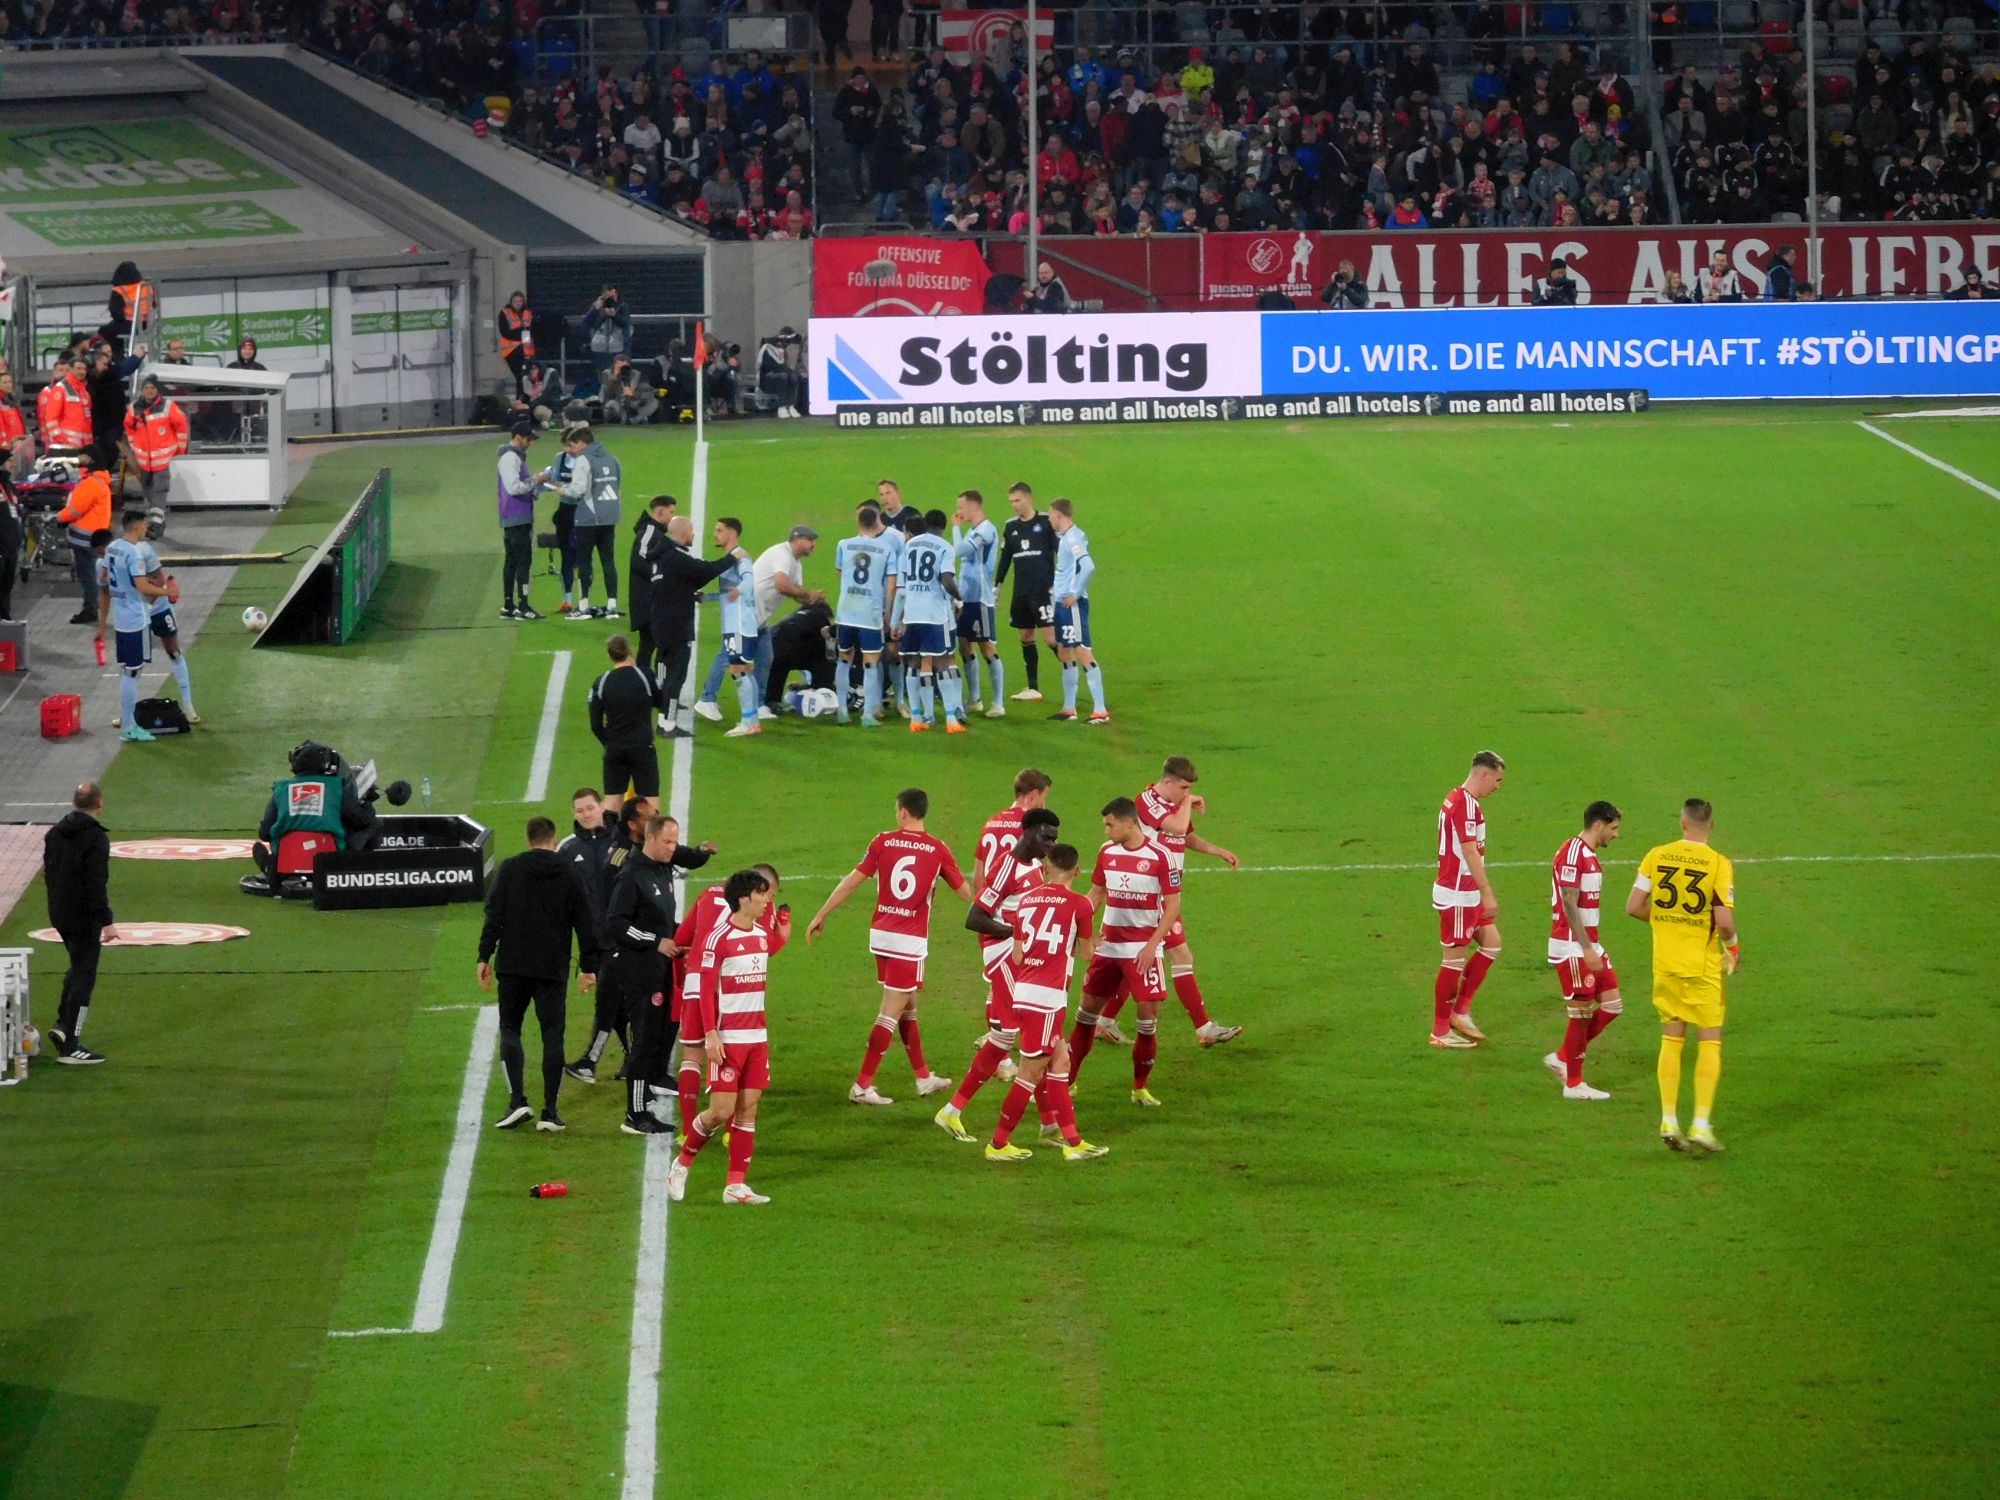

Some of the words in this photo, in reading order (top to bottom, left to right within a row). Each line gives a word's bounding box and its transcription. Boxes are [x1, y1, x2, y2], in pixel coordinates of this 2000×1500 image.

[878, 246, 942, 264] OFFENSIVE
[1367, 241, 1592, 308] ALLES
[1208, 284, 1254, 300] JUGEND
[1280, 283, 1312, 296] TOUR
[900, 331, 1208, 392] Stölting
[1292, 345, 1350, 374] DU.
[1361, 343, 1438, 372] WIR.
[1449, 342, 1505, 371] DIE
[1516, 338, 1766, 369] MANNSCHAFT.
[1043, 407, 1073, 422] me
[1080, 403, 1117, 421] and
[1123, 402, 1147, 420] all
[1154, 400, 1217, 419] hotels
[1246, 402, 1277, 417] me
[1283, 398, 1321, 416] and
[1327, 397, 1351, 414] all
[1357, 395, 1421, 414] hotels
[1450, 398, 1480, 413] me
[1487, 395, 1525, 413] and
[1531, 394, 1554, 412] all
[1561, 393, 1625, 412] hotels
[840, 413, 870, 426] me
[877, 409, 914, 425] and
[920, 407, 944, 424] all
[951, 405, 1014, 424] hotels
[853, 552, 871, 585] 8
[907, 549, 936, 582] 18
[1061, 625, 1076, 640] 22
[380, 836, 425, 847] IGA.DE
[884, 838, 936, 853] DÜSSELDORF
[1659, 852, 1711, 866] DÜSSELDORF
[326, 869, 473, 888] BUNDESLIGA.COM
[890, 855, 916, 900] 6
[1654, 865, 1708, 914] 33
[1018, 906, 1064, 955] 34
[1654, 915, 1704, 926] KASTENMEIER
[1144, 968, 1159, 986] 15
